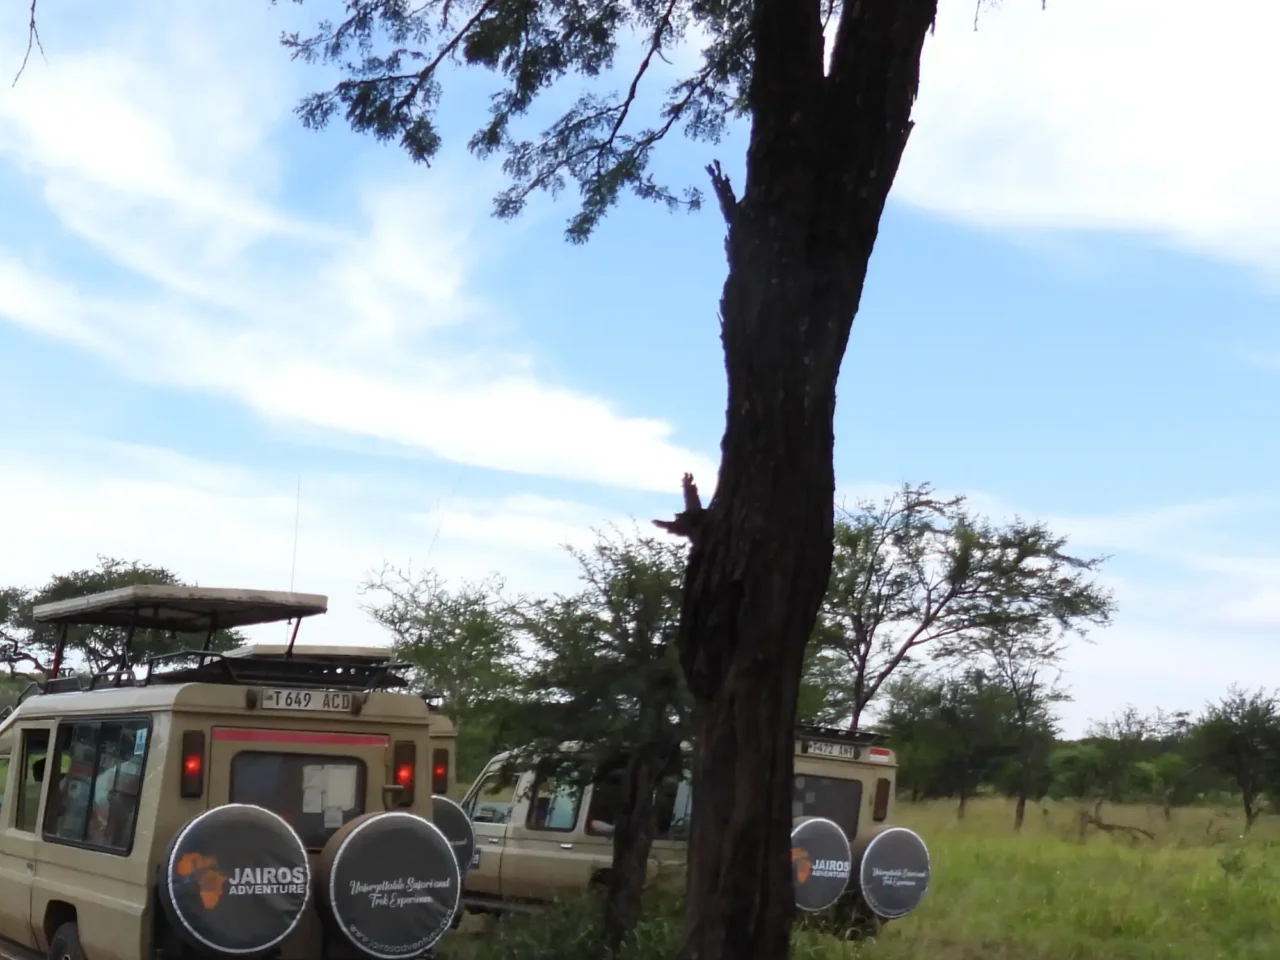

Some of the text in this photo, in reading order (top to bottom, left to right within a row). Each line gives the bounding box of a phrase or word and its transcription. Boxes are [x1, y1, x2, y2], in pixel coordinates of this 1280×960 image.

[274, 691, 350, 709] T 649 ACD
[812, 860, 849, 872] JAIROS
[228, 867, 305, 885] JAIROS
[228, 884, 305, 895] ADVENTURE
